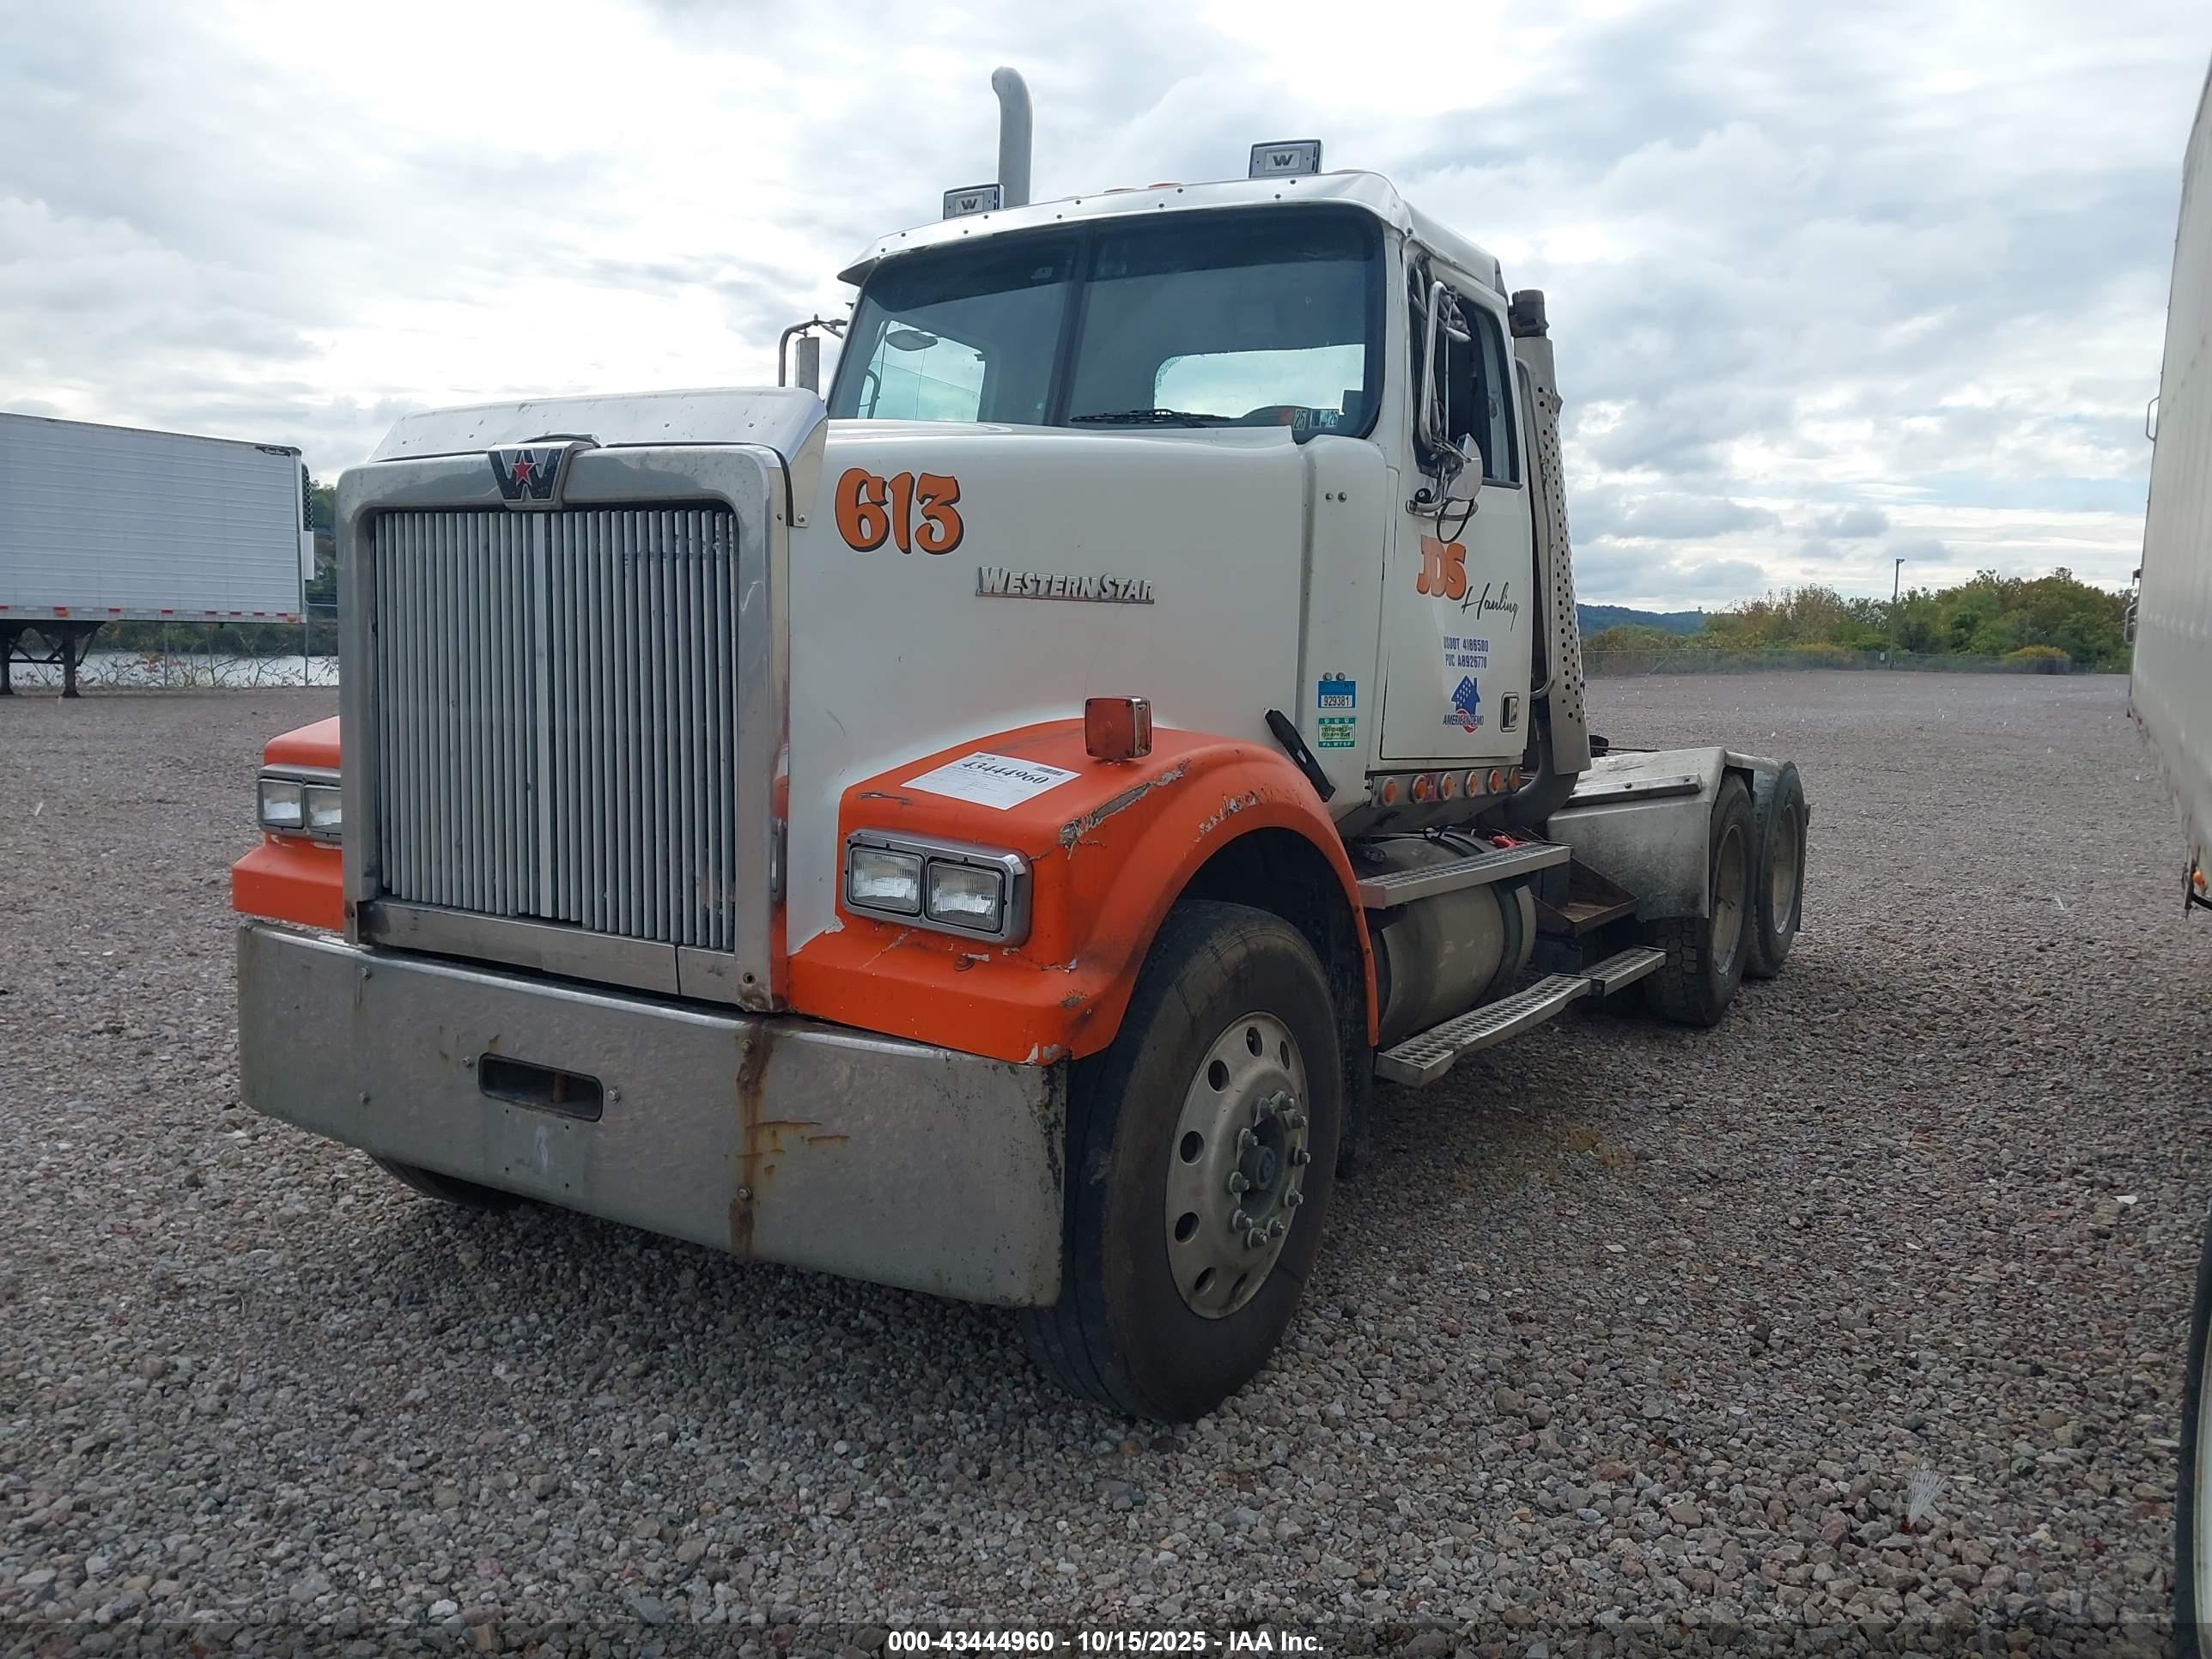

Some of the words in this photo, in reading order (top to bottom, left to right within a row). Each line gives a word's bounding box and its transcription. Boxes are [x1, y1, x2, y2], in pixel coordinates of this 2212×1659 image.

[1273, 154, 1293, 167] W
[961, 198, 978, 210] W
[1294, 410, 1306, 428] 25
[835, 467, 964, 555] 613
[1417, 535, 1468, 600] JDS
[1461, 581, 1518, 632] Hauling
[1443, 636, 1460, 650] USDOT
[1462, 638, 1489, 653] 4186500
[1445, 653, 1455, 666] PUC
[1457, 654, 1487, 669] A8926770
[1323, 696, 1349, 706] 929381
[961, 761, 1049, 784] 43444960
